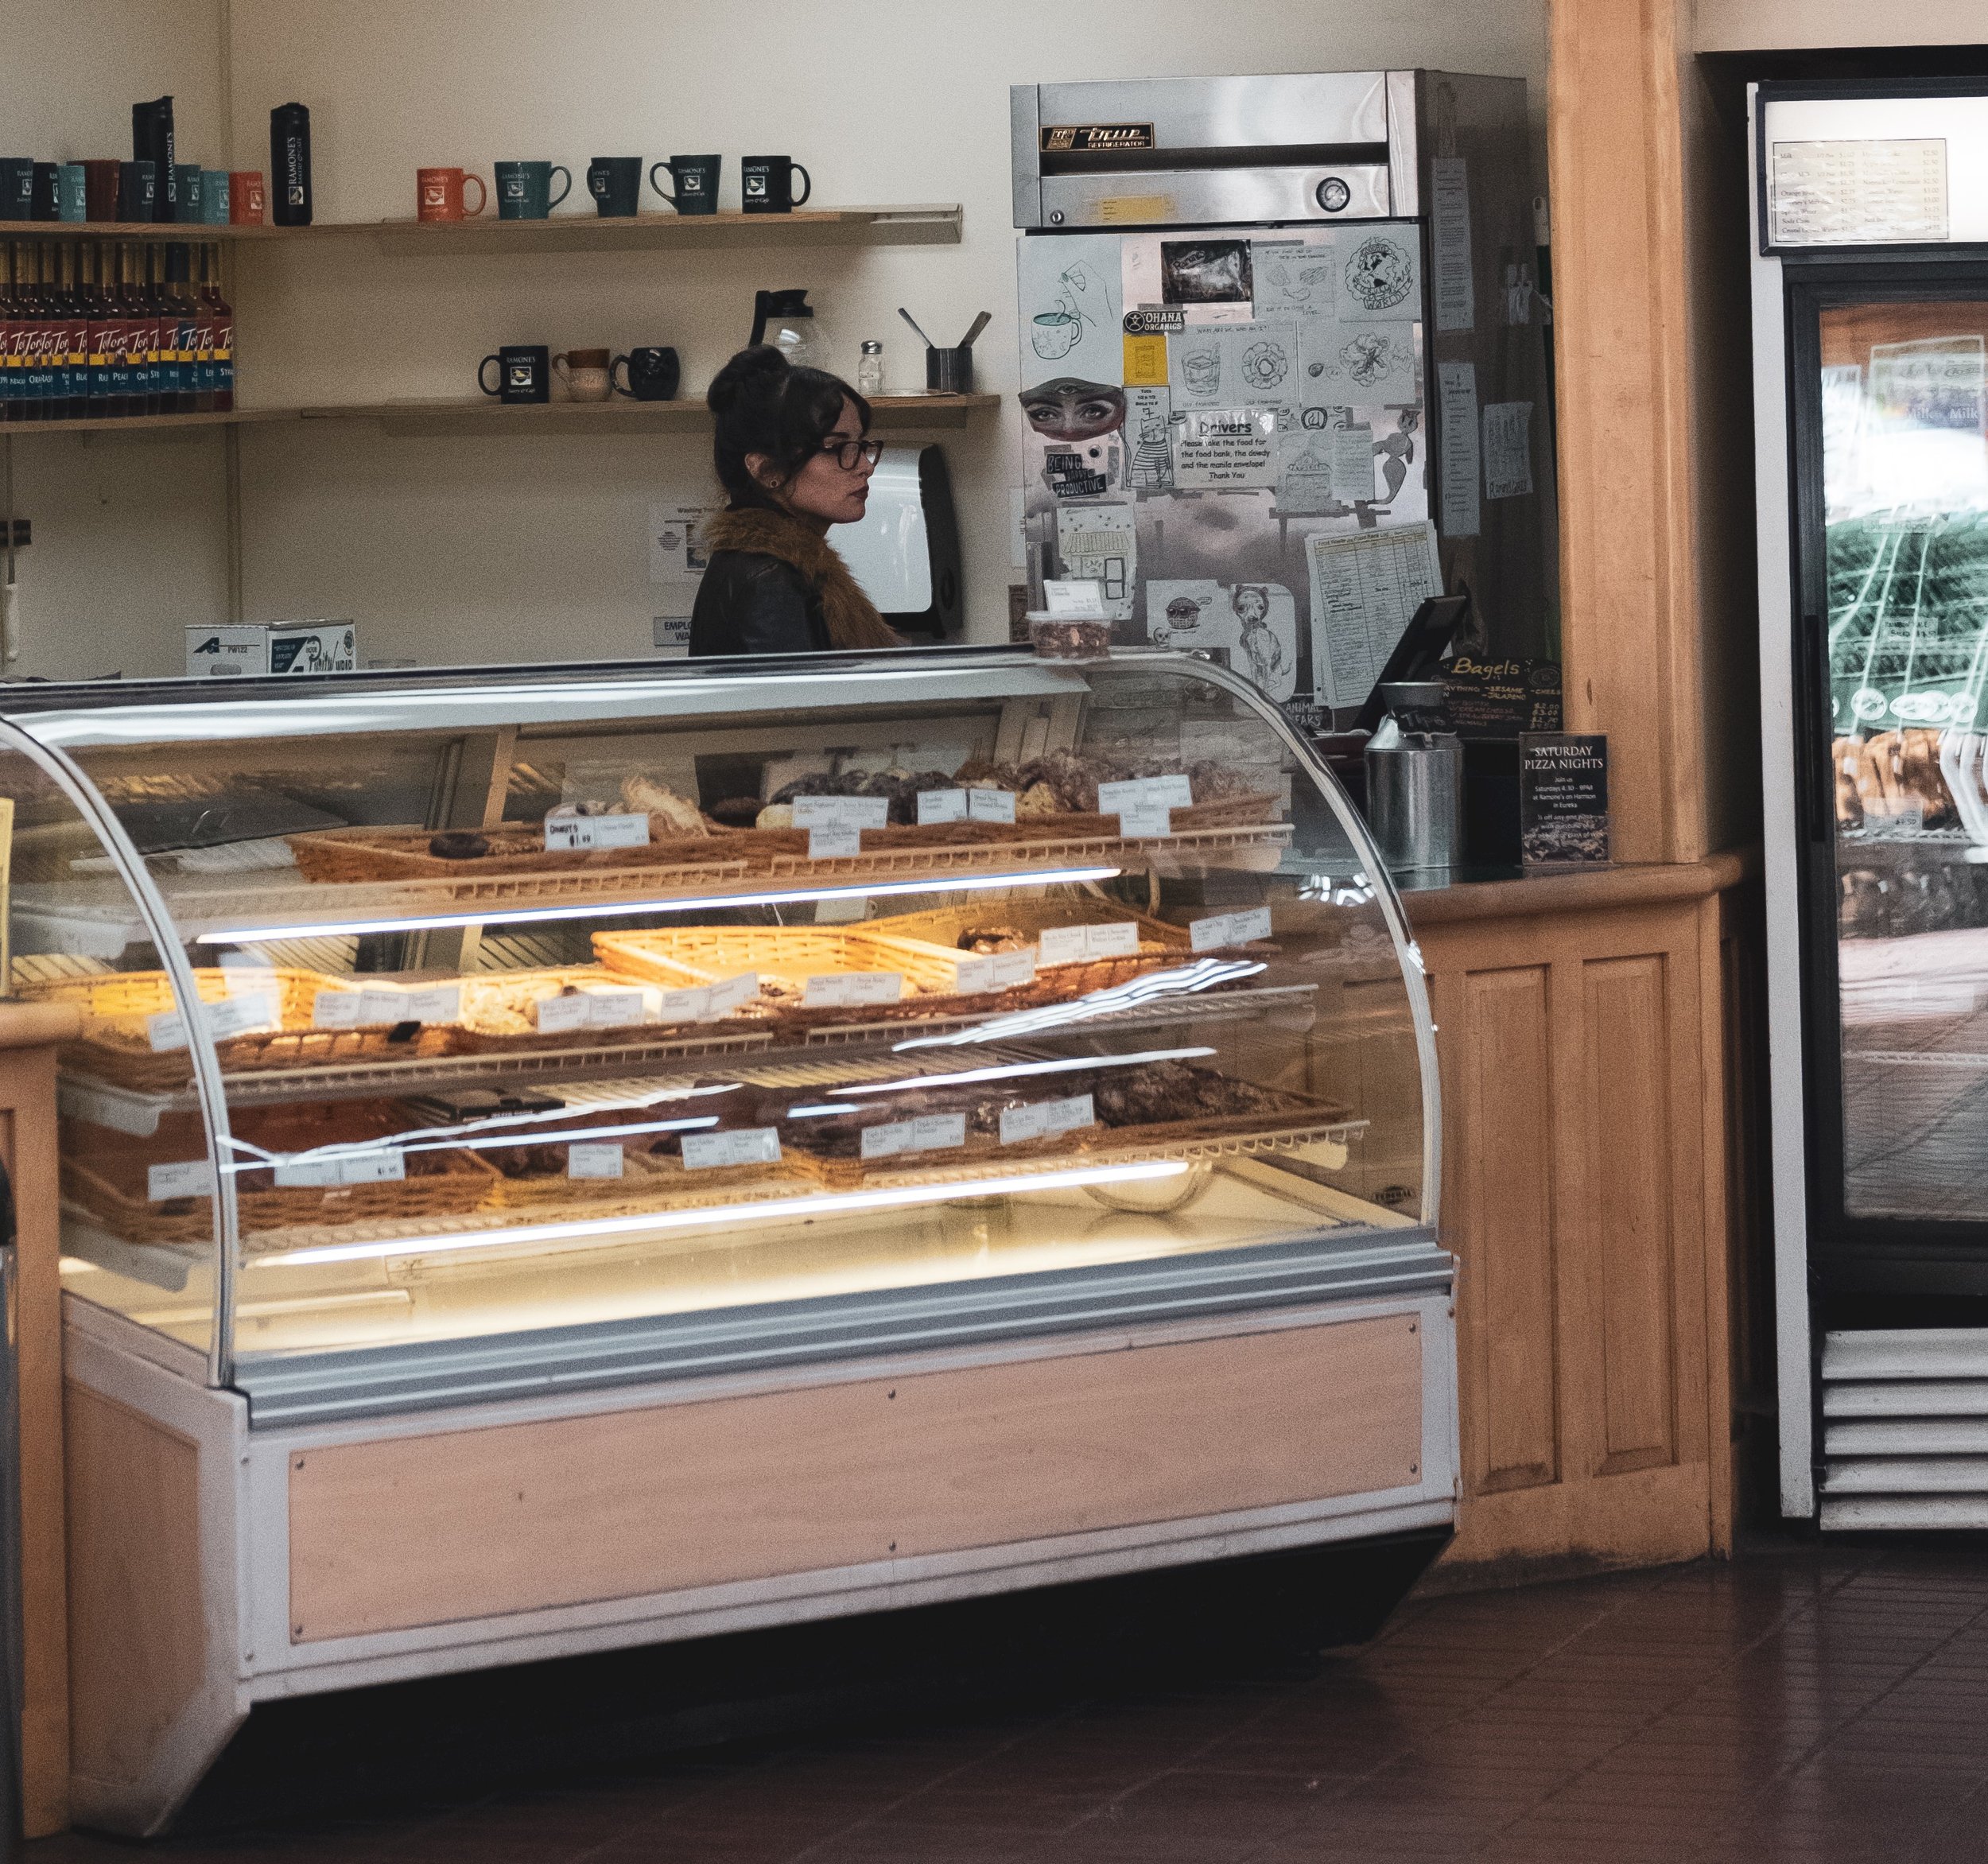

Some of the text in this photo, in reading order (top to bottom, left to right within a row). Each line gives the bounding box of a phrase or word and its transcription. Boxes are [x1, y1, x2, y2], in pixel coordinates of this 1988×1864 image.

[1144, 322, 1182, 331] ORGANICS
[1200, 420, 1252, 434] Drivers
[1047, 455, 1081, 472] BEING
[1055, 477, 1104, 495] PRODUCTIVE
[664, 621, 692, 631] EMPLO
[675, 631, 690, 641] WA
[1451, 657, 1520, 680] Bagels
[1534, 745, 1593, 756] SATURDAY
[1524, 759, 1603, 770] PIZZA NIGHTS
